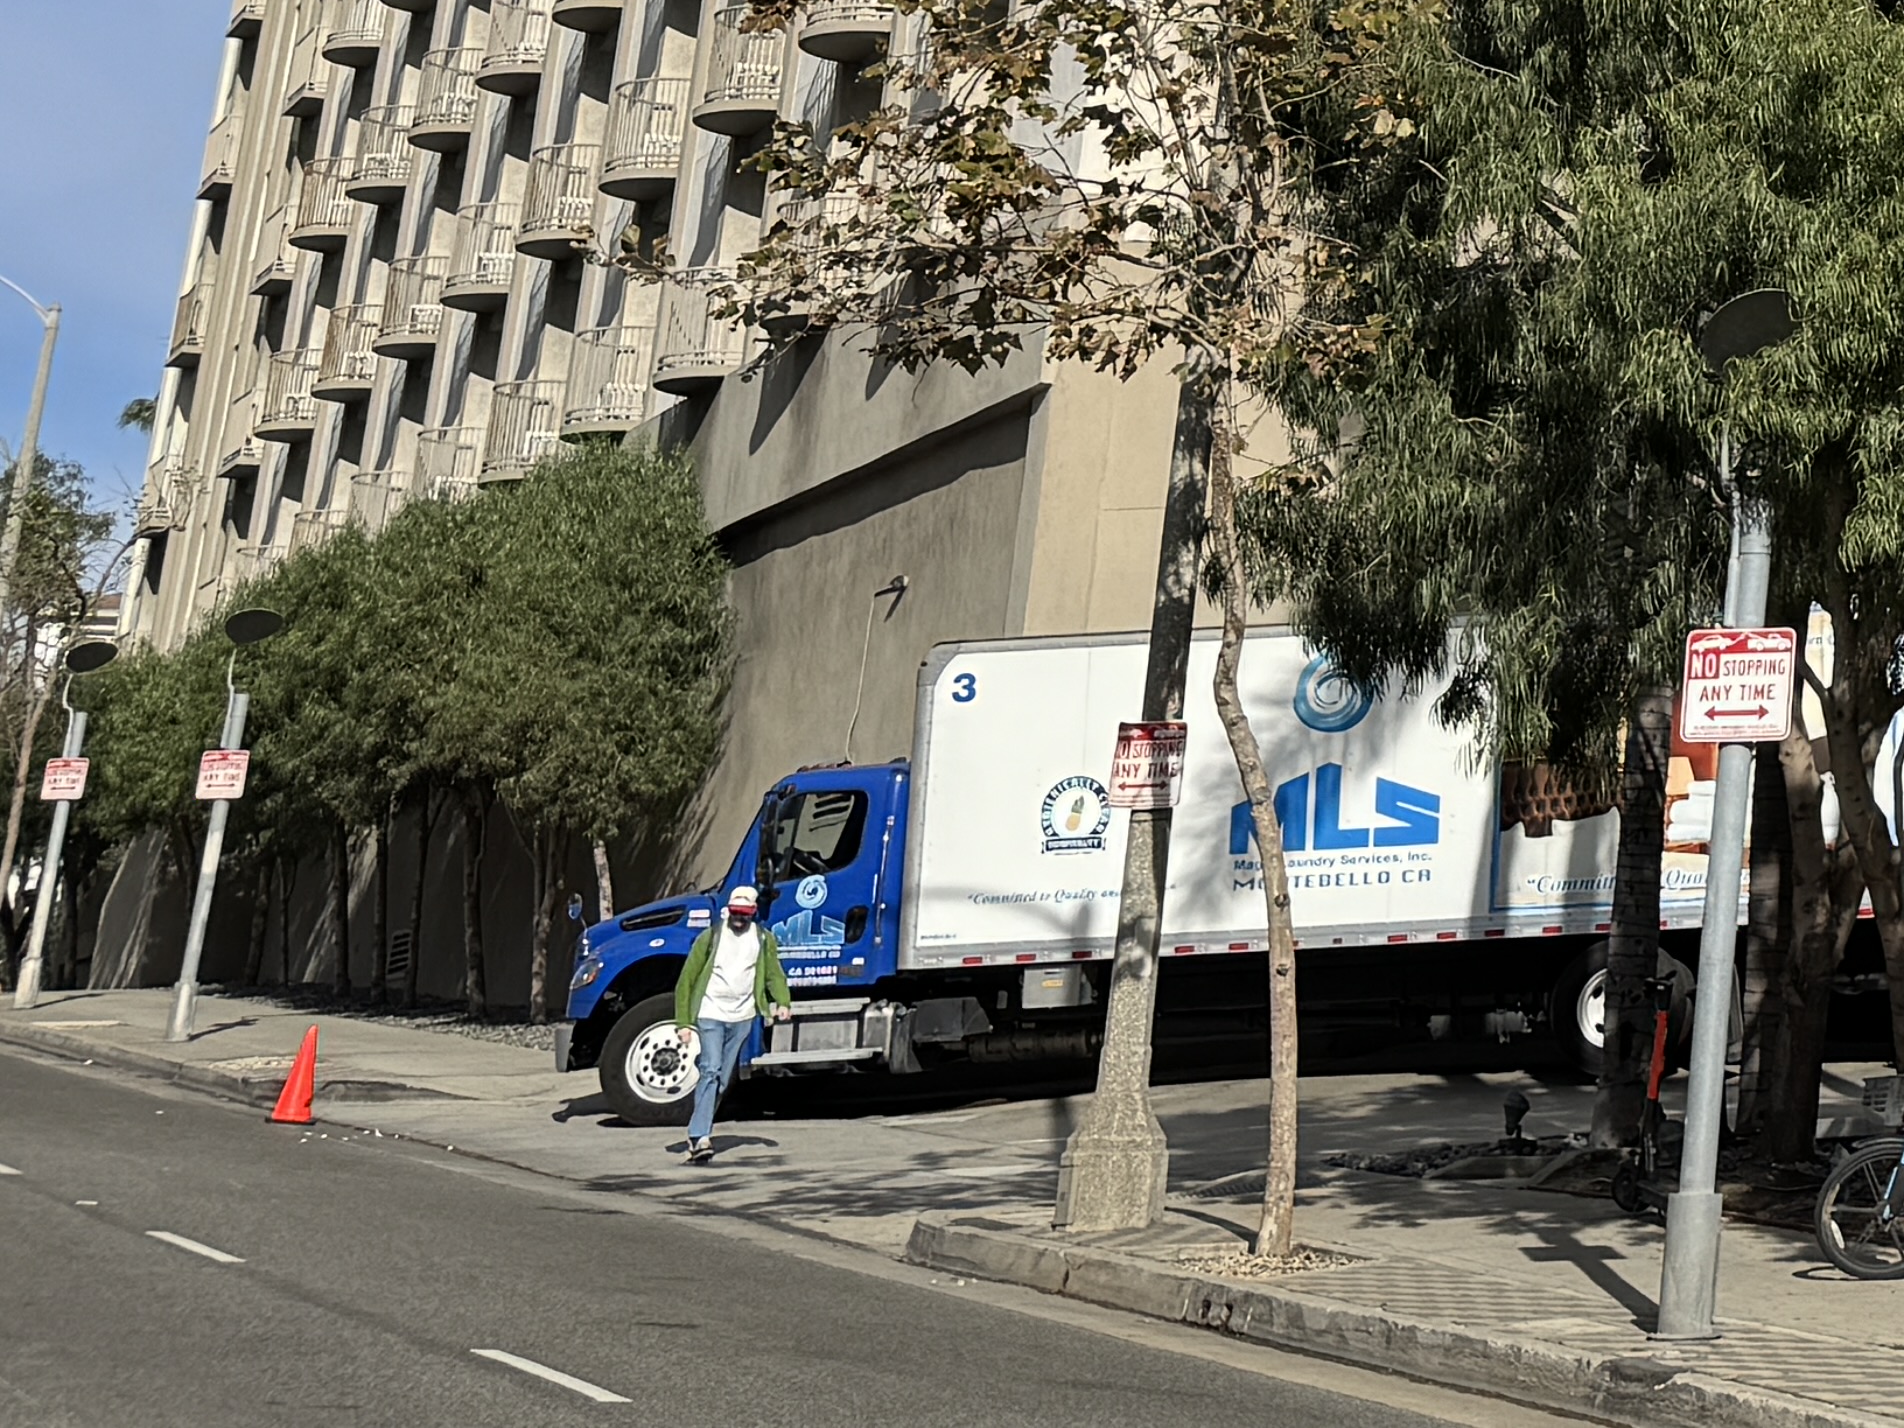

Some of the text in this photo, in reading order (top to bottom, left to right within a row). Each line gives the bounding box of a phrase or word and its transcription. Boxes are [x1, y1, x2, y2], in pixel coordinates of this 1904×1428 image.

[1691, 653, 1786, 678] NO STOPPING
[951, 673, 977, 702] 3
[1699, 683, 1776, 702] ANY TIME
[1132, 741, 1184, 758] STOPPING
[1114, 761, 1181, 778] ANY TIME
[1229, 762, 1440, 854] MLS
[1408, 851, 1432, 861] Inc.
[1402, 869, 1431, 883] CA
[771, 910, 846, 945] MLS
